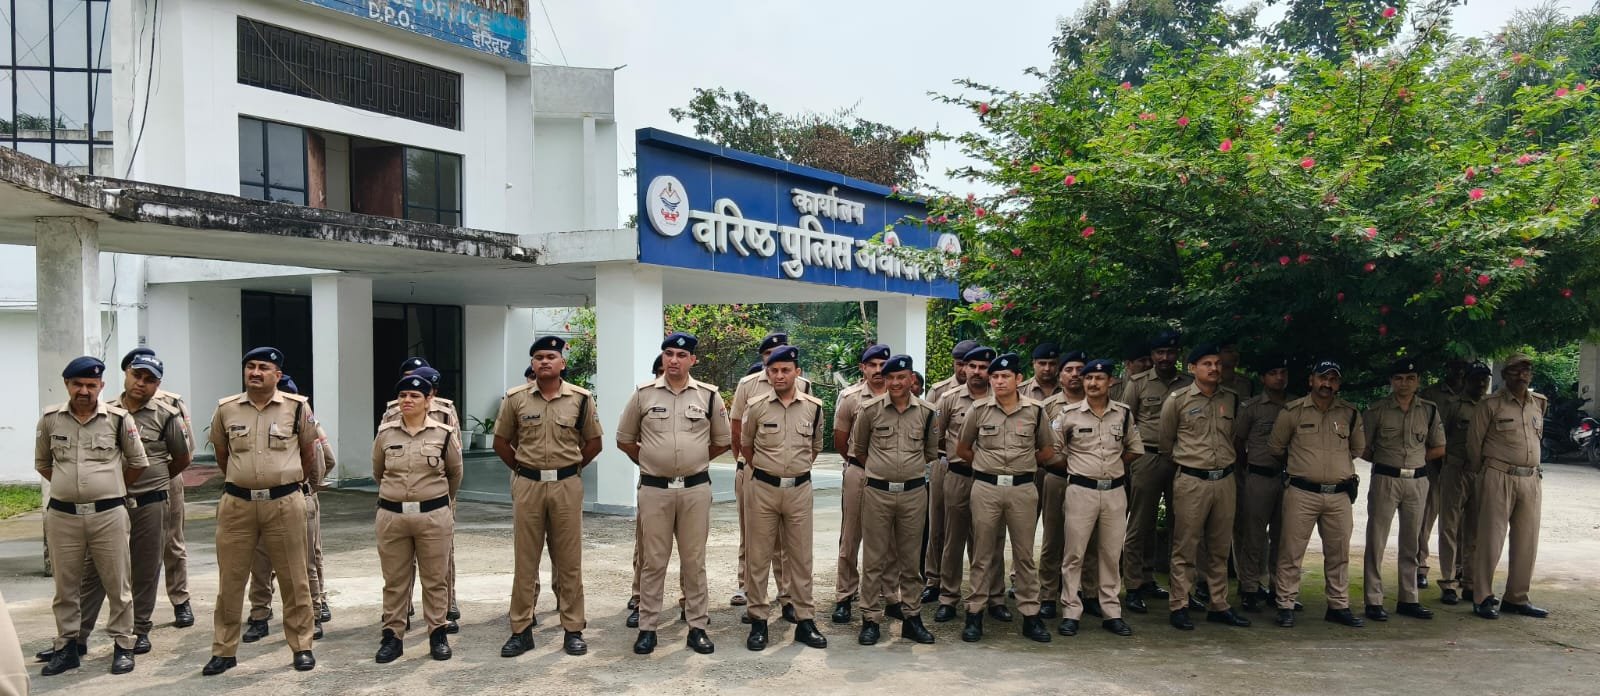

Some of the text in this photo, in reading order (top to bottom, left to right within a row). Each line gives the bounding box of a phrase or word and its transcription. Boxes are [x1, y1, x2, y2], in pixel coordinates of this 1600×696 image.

[368, 1, 416, 29] D.P.O.
[791, 186, 865, 224] कार्यालय
[688, 198, 778, 257] वरिष्ठ
[777, 214, 854, 278] पुलिस
